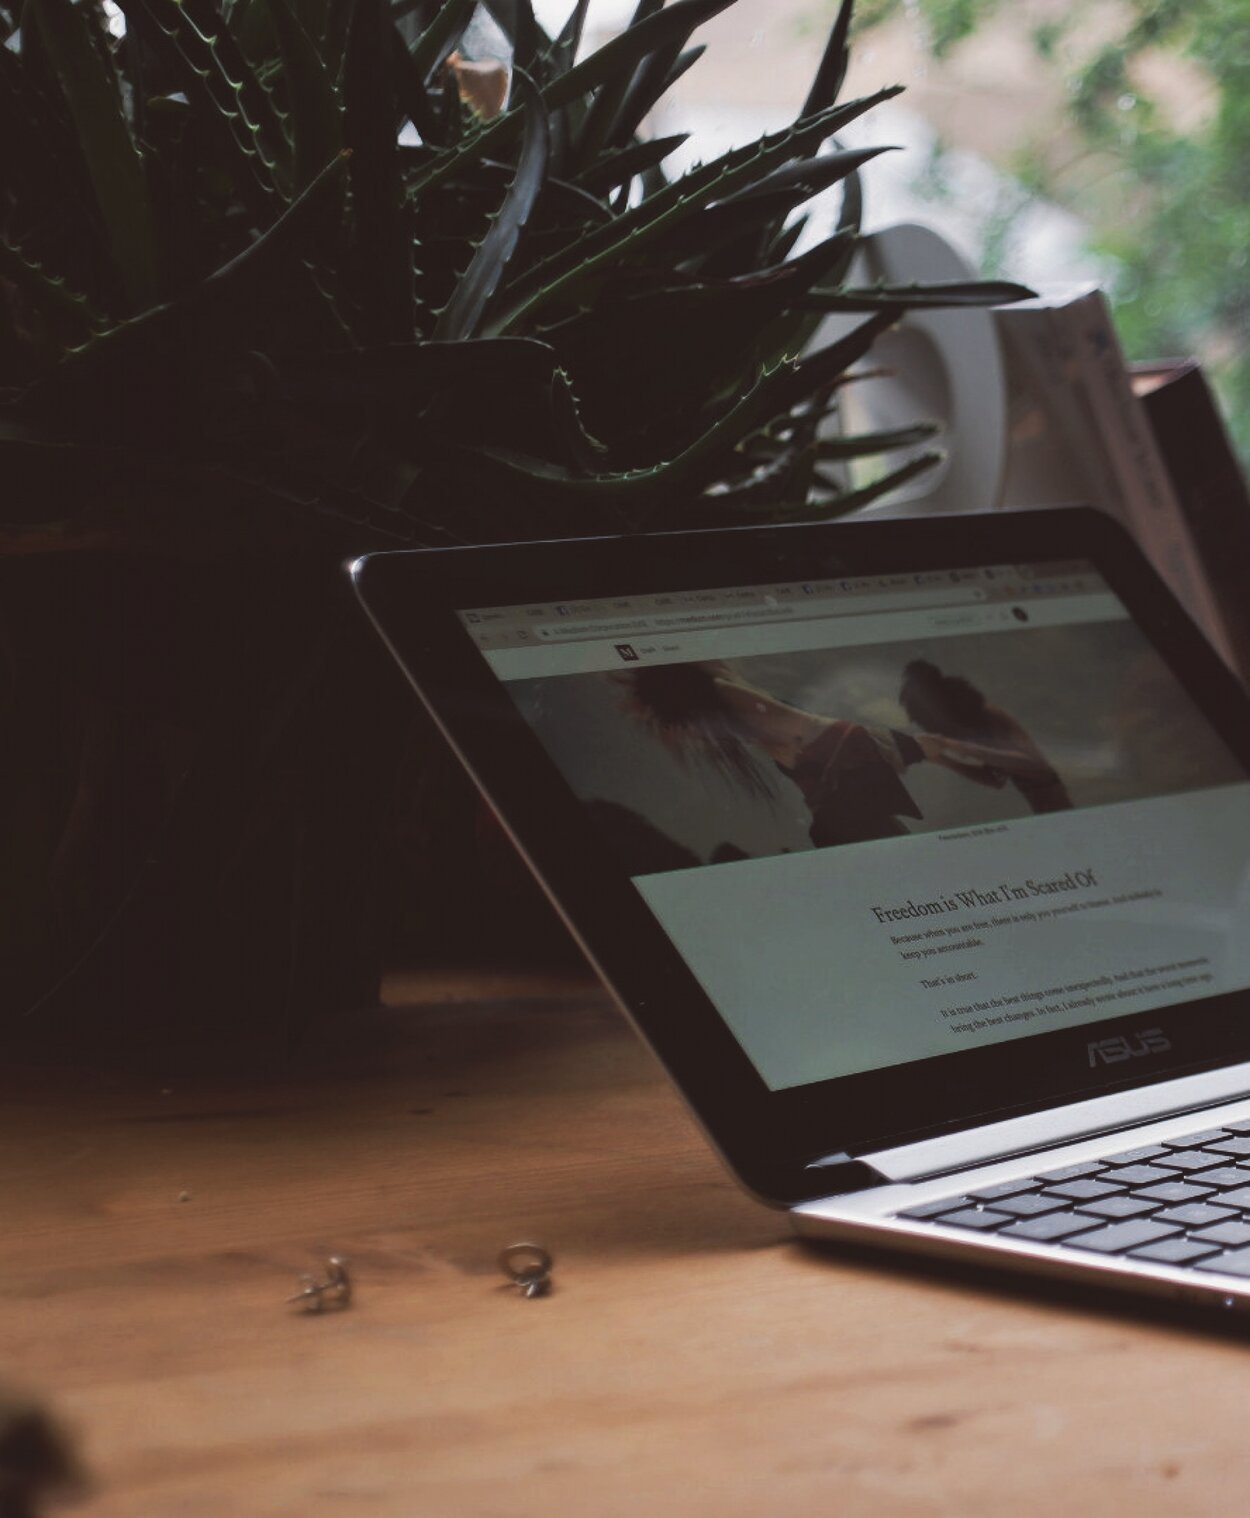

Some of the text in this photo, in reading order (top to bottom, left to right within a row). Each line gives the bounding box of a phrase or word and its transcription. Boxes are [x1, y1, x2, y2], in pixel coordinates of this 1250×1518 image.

[871, 868, 1098, 923] Freedom is What I'm Scared Of
[890, 934, 923, 944] Because
[923, 929, 946, 938] when
[944, 927, 961, 936] you
[990, 917, 1011, 926] there
[1036, 910, 1051, 919] you
[899, 951, 921, 960] keep
[920, 948, 937, 958] you
[954, 972, 977, 982] short.
[950, 1023, 975, 1033] bring
[972, 1020, 988, 1029] the
[985, 1016, 1004, 1026] best
[1045, 1004, 1065, 1013] fact,
[1067, 997, 1095, 1009] already
[955, 1006, 974, 1014] true
[971, 1001, 991, 1011] that
[989, 999, 1005, 1008] the
[1002, 996, 1020, 1005] best
[1020, 991, 1045, 1002] things
[1044, 987, 1065, 996] come
[1087, 1027, 1171, 1068] ASUS
